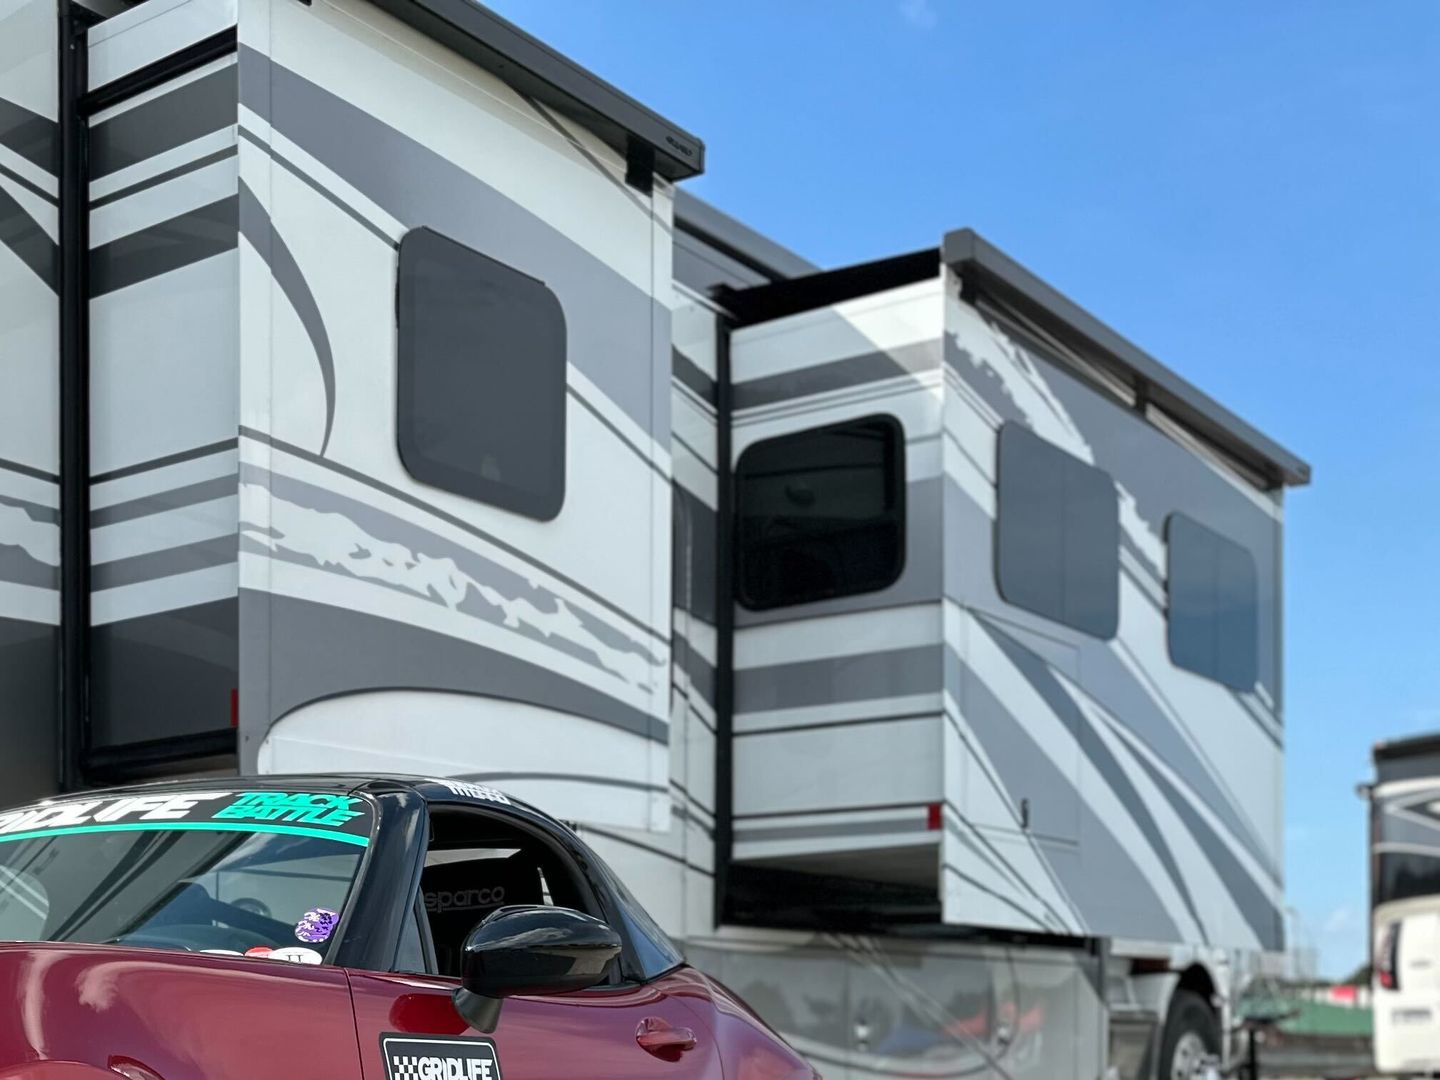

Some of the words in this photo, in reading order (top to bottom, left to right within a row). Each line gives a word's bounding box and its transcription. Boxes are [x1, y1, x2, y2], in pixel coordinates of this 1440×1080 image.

[235, 791, 365, 810] TRACK
[212, 804, 365, 826] BATTLE
[424, 886, 505, 913] sparco
